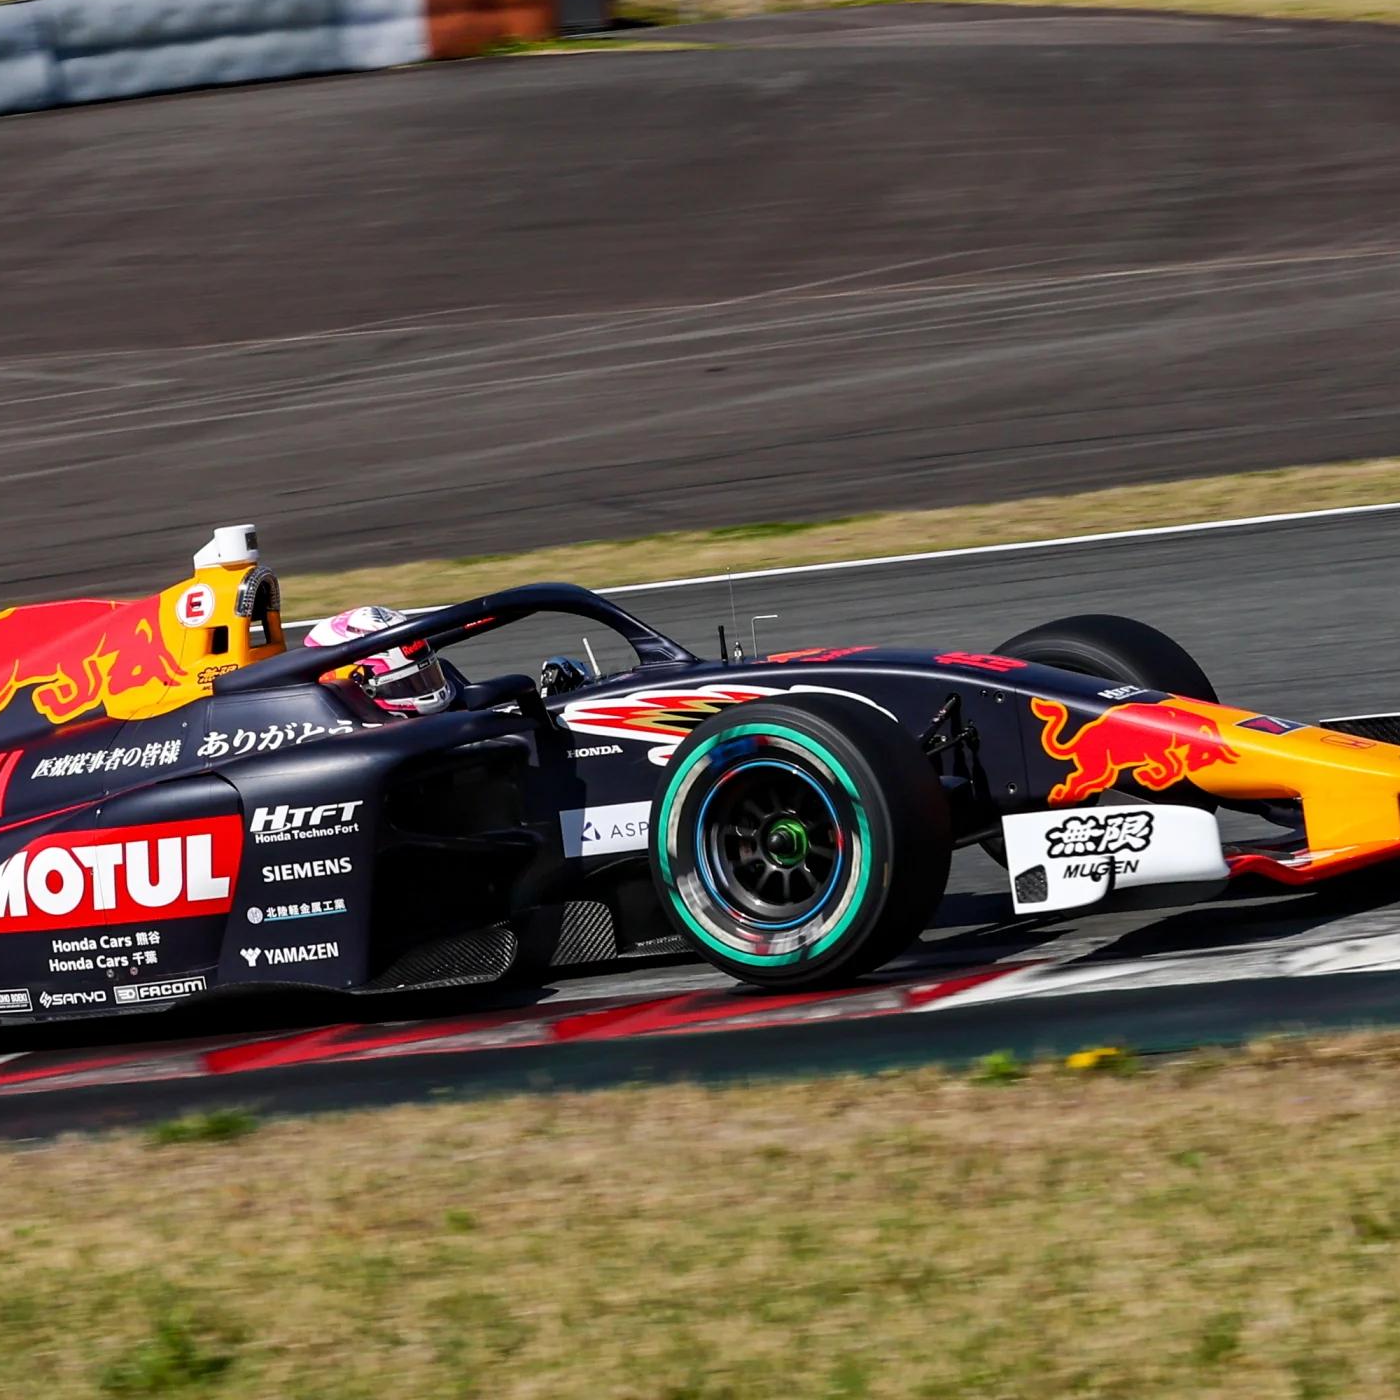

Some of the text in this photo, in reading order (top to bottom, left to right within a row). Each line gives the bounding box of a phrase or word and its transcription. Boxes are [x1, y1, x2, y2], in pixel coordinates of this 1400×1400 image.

[186, 592, 205, 618] E
[31, 740, 181, 779] 医療従事者の皆様
[567, 744, 623, 758] HONDA
[250, 800, 364, 832] HTFT
[255, 831, 291, 844] Honda
[1046, 811, 1153, 858] 無限
[262, 857, 353, 883] SIEMENS
[1062, 859, 1140, 879] MUGEN
[52, 937, 97, 953] Honda
[100, 935, 133, 949] Cars
[264, 941, 340, 965] YAMAZEN
[49, 950, 158, 972] Honda Cars 千葉
[52, 990, 107, 1006] SANYO
[140, 980, 203, 998] FACOM
